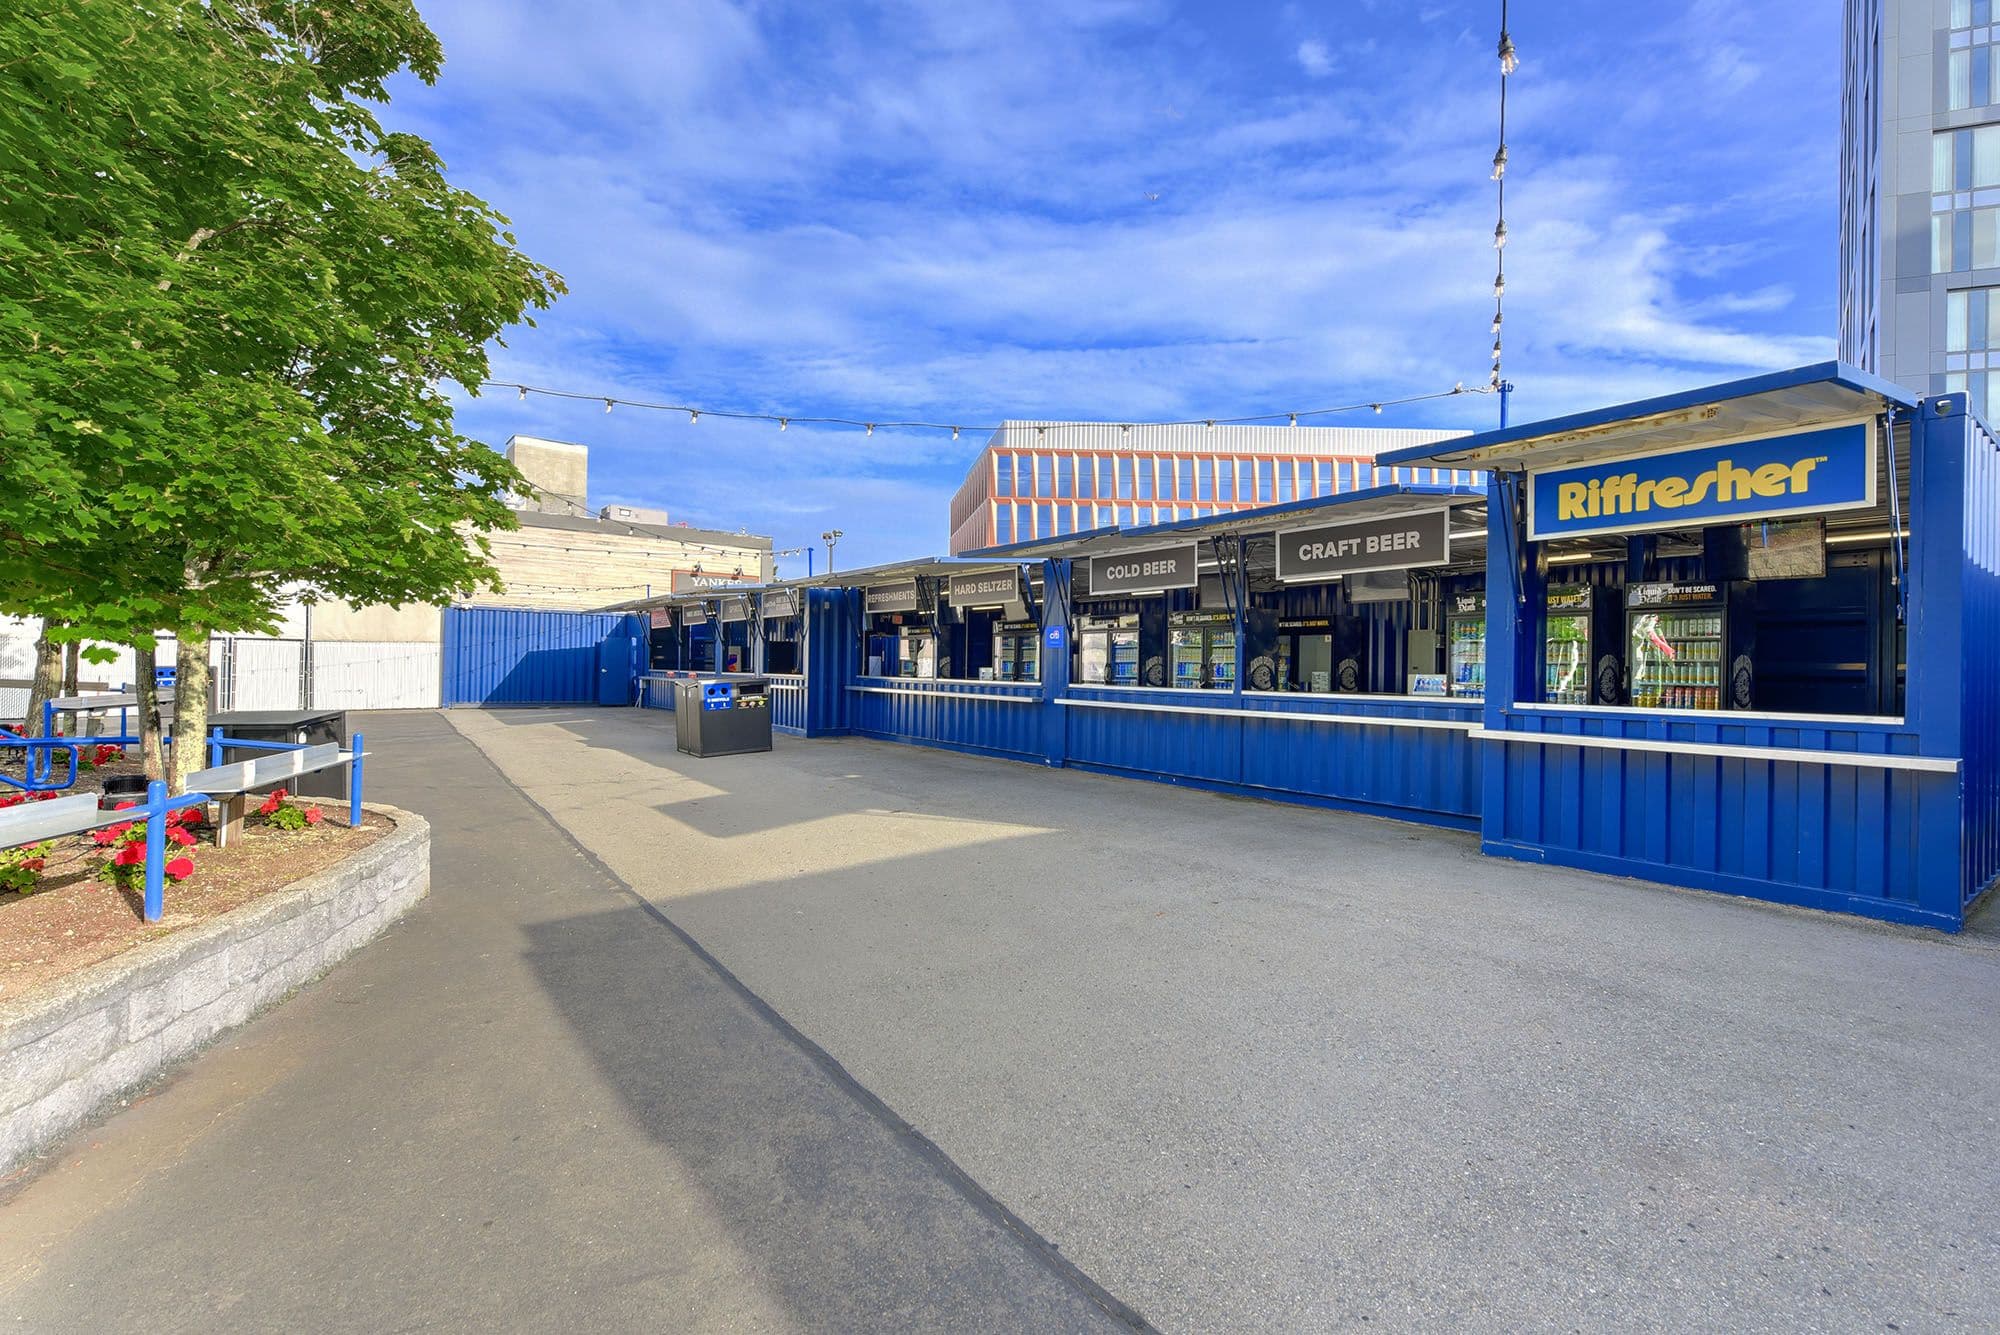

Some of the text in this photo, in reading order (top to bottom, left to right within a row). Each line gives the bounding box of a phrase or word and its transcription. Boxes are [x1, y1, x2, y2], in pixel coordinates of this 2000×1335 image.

[1298, 530, 1421, 561] CRAFT BEER
[1106, 559, 1177, 580] COLD BEER
[954, 579, 1013, 596] HARD SELTZER
[867, 590, 915, 603] REFRESHMENTS
[1547, 596, 1560, 604] UST
